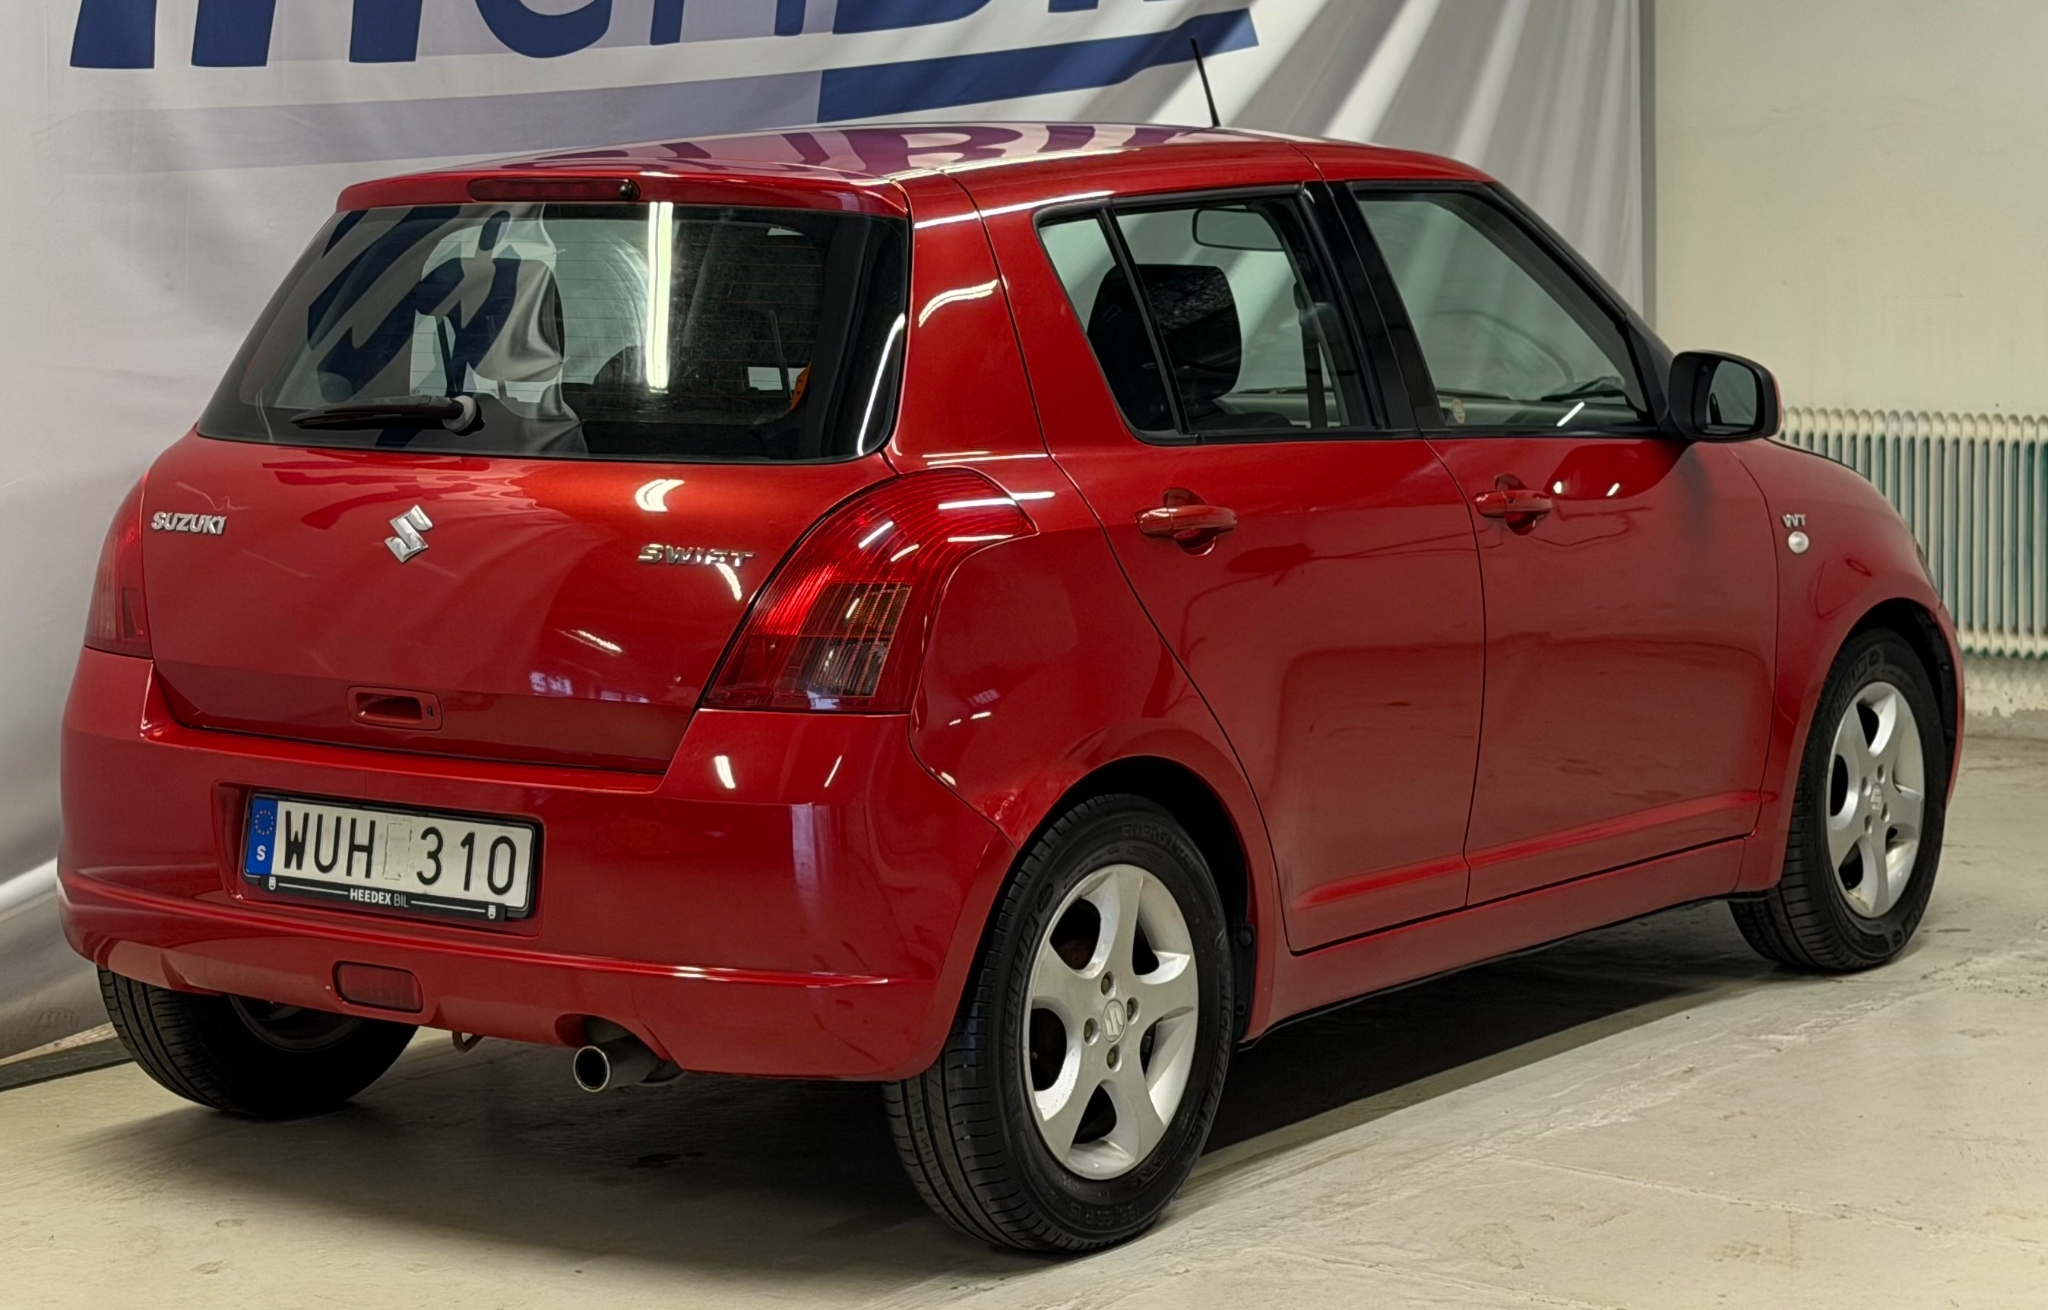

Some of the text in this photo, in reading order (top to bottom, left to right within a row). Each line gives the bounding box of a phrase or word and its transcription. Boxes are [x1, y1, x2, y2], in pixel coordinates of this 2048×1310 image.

[151, 511, 227, 535] SUZUKI
[1781, 513, 1806, 528] VVT
[637, 543, 755, 567] SWIFT
[256, 844, 267, 861] S
[284, 809, 517, 896] WUH 310
[350, 887, 410, 908] HEEDEX BIL
